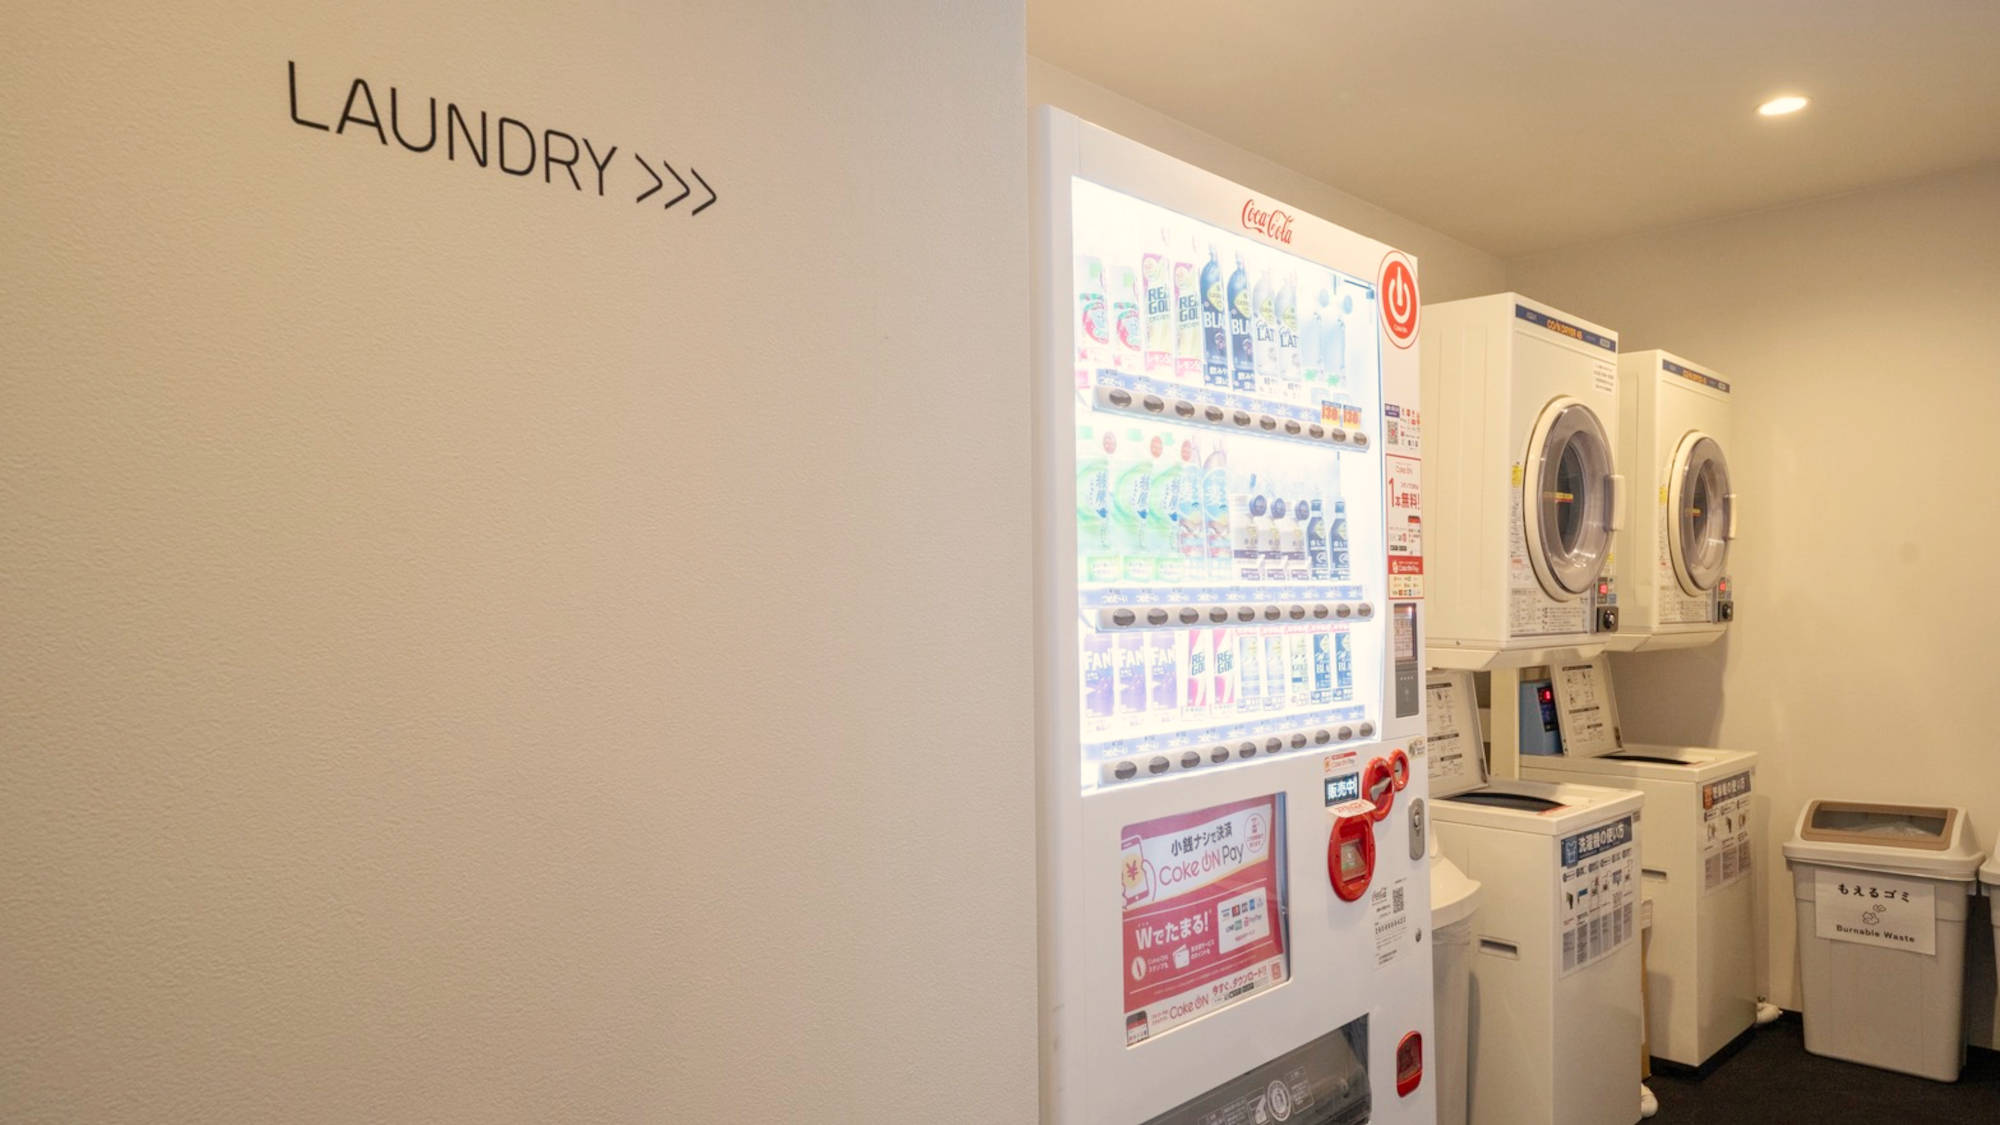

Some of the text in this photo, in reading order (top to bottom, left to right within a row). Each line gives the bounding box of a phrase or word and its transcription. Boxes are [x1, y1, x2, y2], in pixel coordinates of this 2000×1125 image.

[288, 60, 618, 197] LAUNDRY
[1170, 821, 1233, 857] 小銭ナシで決済
[1158, 860, 1200, 886] Coke
[1222, 842, 1244, 866] Pay
[1838, 882, 1911, 904] もえるゴミ
[1135, 910, 1209, 951] Wでたまる!
[1836, 923, 1915, 943] Burnable Waste
[1169, 1001, 1194, 1020] Coke
